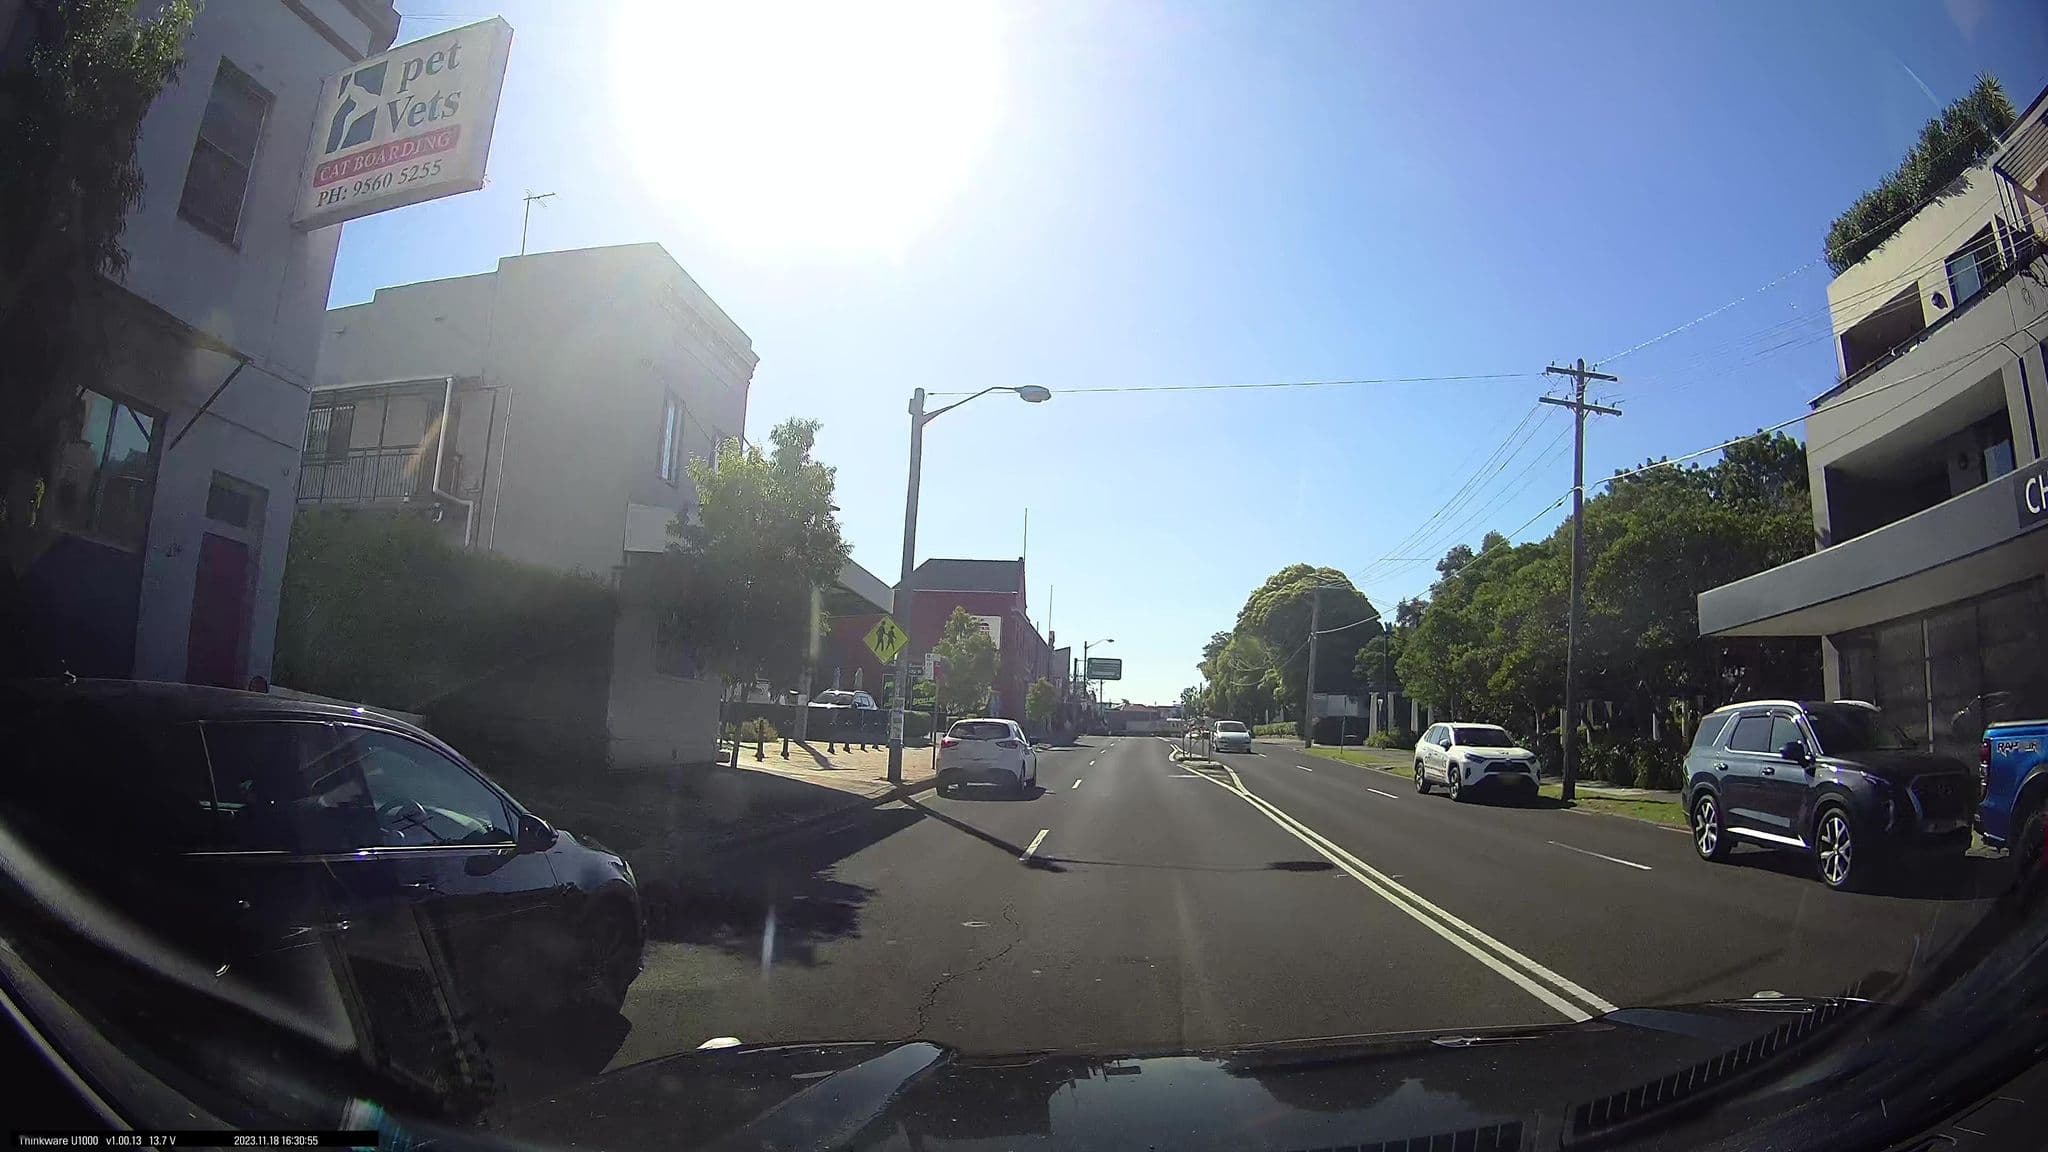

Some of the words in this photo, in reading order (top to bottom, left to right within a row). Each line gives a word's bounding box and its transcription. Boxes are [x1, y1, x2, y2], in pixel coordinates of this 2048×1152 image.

[397, 40, 462, 94] pet
[386, 91, 461, 133] Vets
[320, 160, 350, 181] CAT
[353, 131, 450, 172] BOARDING
[315, 185, 348, 208] PH:
[352, 172, 393, 197] 9560
[398, 159, 443, 185] 5255
[1997, 741, 2038, 753] RAPR
